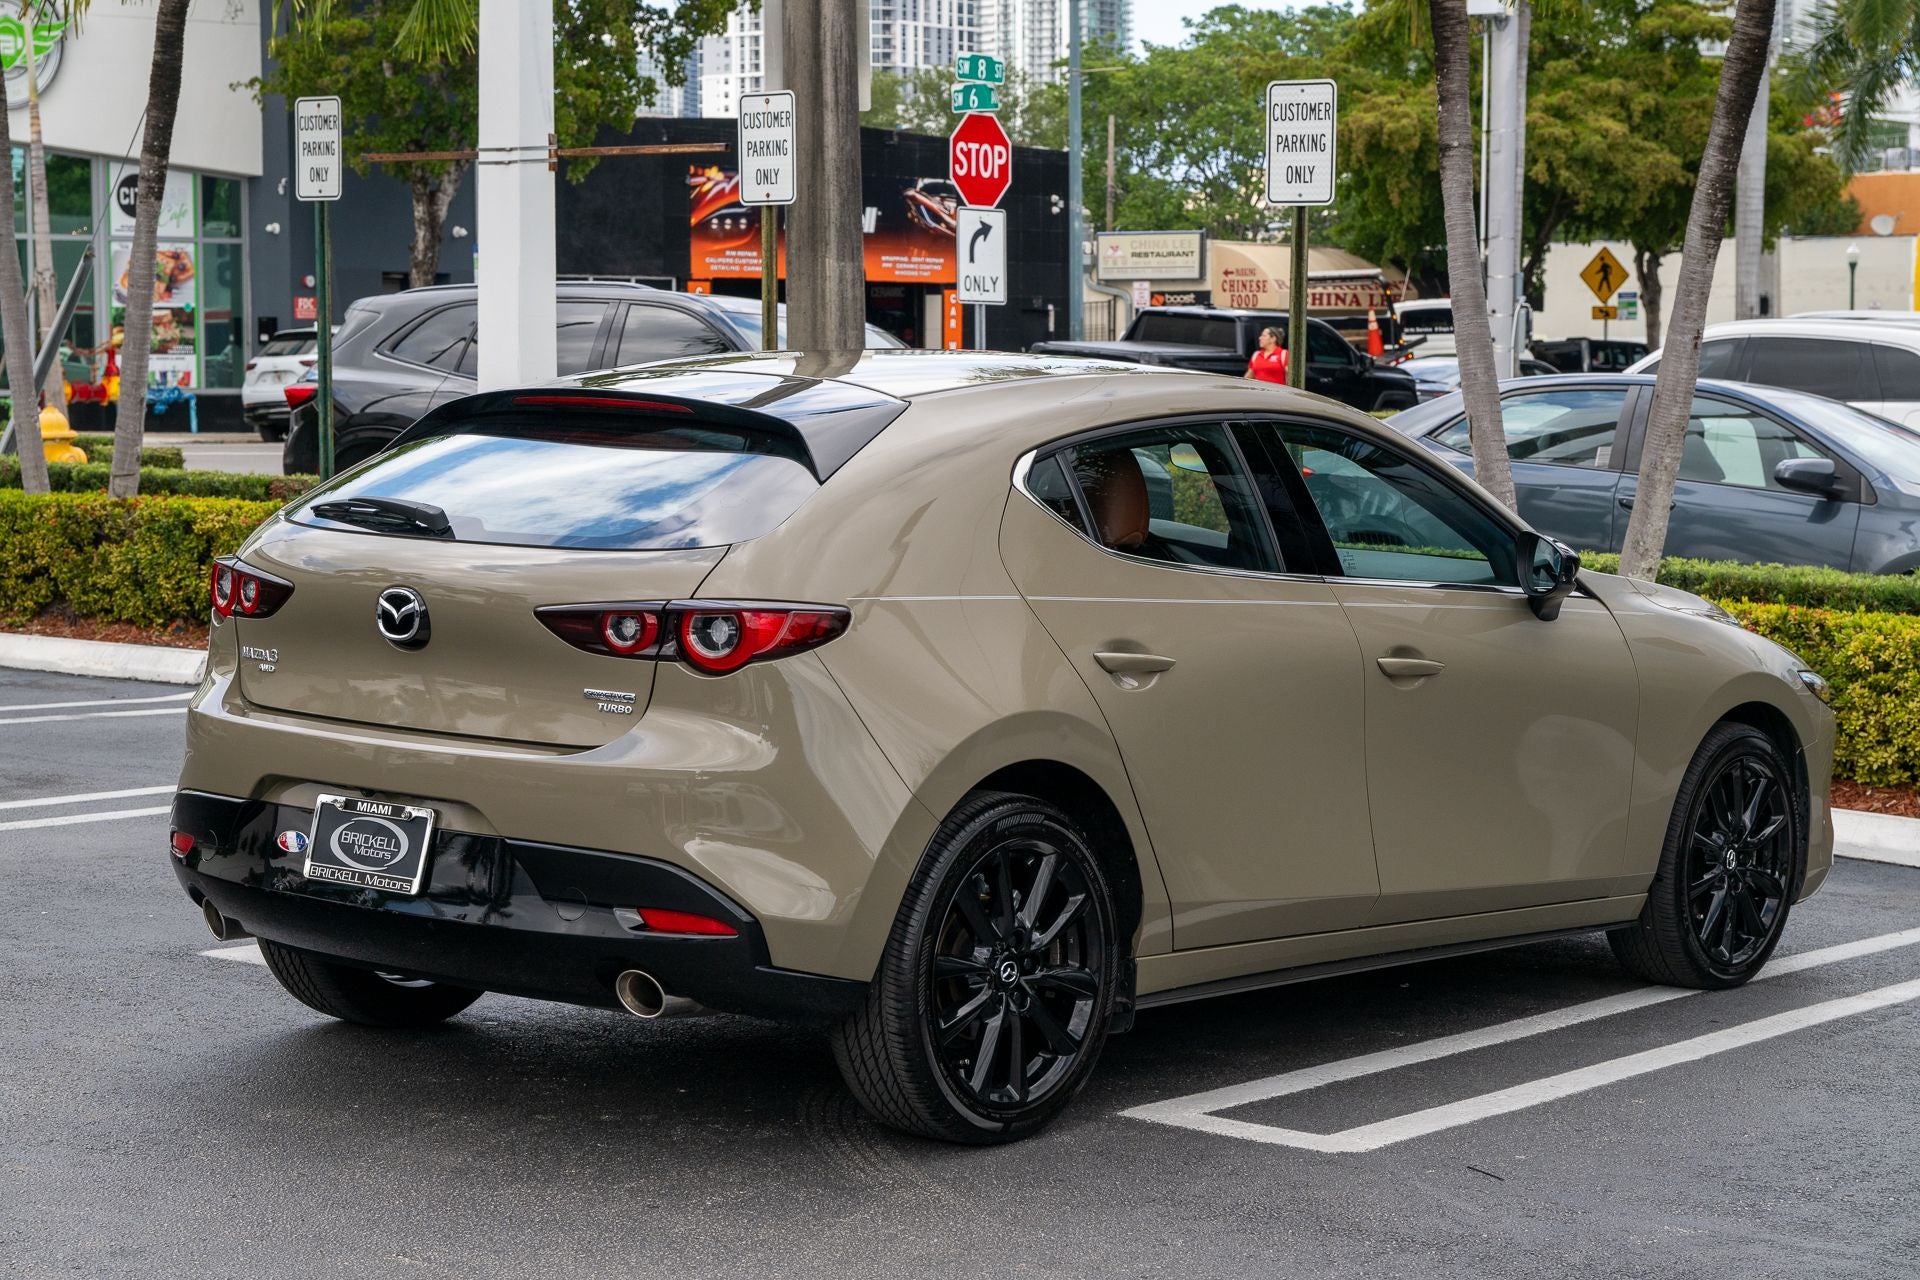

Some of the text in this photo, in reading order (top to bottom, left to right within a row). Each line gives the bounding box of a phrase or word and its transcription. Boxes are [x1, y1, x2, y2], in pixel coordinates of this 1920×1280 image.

[977, 58, 987, 80] 8
[994, 63, 1003, 79] ST
[969, 87, 979, 109] 6
[742, 111, 791, 130] CUSTOMER
[1272, 102, 1331, 122] CUSTOMER
[299, 115, 338, 131] CUSTOMER
[302, 141, 336, 157] PARKING
[747, 139, 788, 158] PARKING
[1276, 134, 1326, 153] PARKING
[954, 141, 1008, 179] STOP
[309, 166, 329, 183] ONLY
[755, 168, 780, 186] ONLY
[1286, 165, 1315, 184] ONLY
[1130, 250, 1196, 259] RESTAURANT
[964, 275, 999, 293] ONLY
[1221, 279, 1268, 293] CHINESE
[1165, 293, 1196, 304] boost
[1230, 293, 1259, 308] FOOD
[597, 702, 633, 714] TURBO
[356, 801, 393, 816] MIAMI
[340, 830, 399, 852] BRICKELL
[353, 844, 392, 861] Motors
[309, 864, 412, 892] BRICKELL Motors
